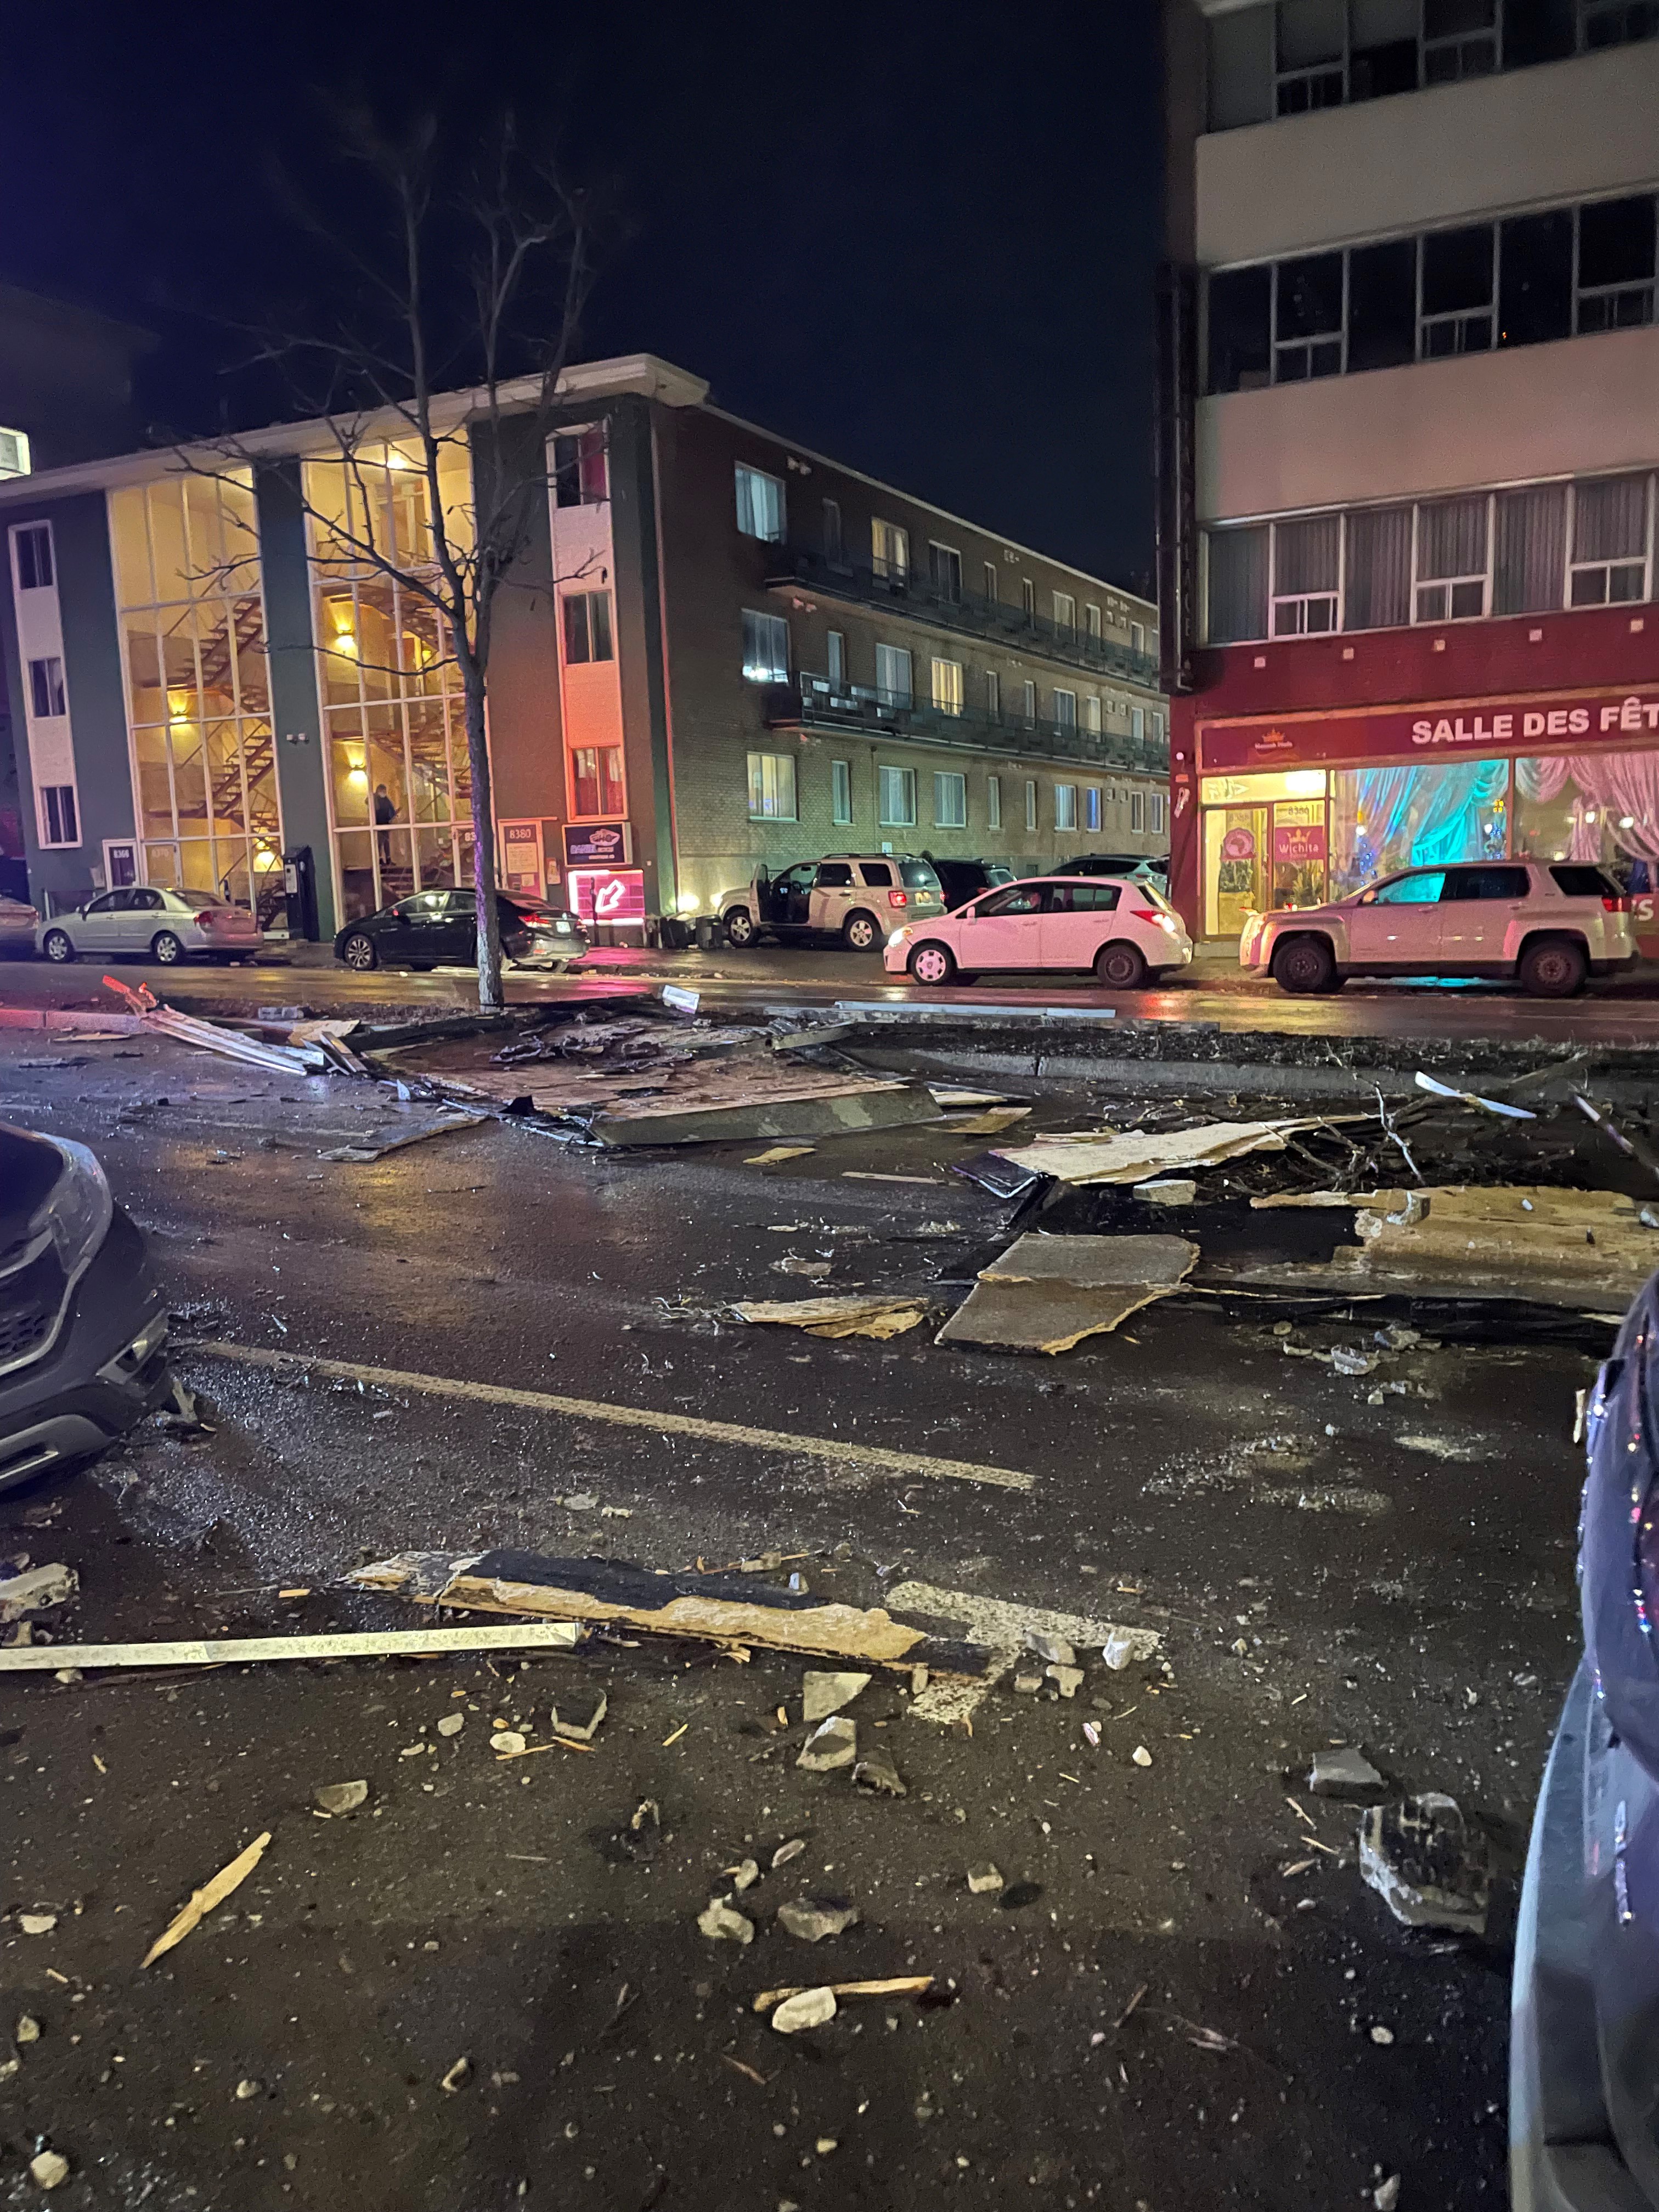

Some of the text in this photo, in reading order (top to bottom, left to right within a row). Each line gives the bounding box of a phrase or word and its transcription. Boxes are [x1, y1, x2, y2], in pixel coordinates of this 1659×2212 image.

[1412, 696, 1659, 744] SALLE DES FÊT
[1279, 843, 1319, 853] Wichita
